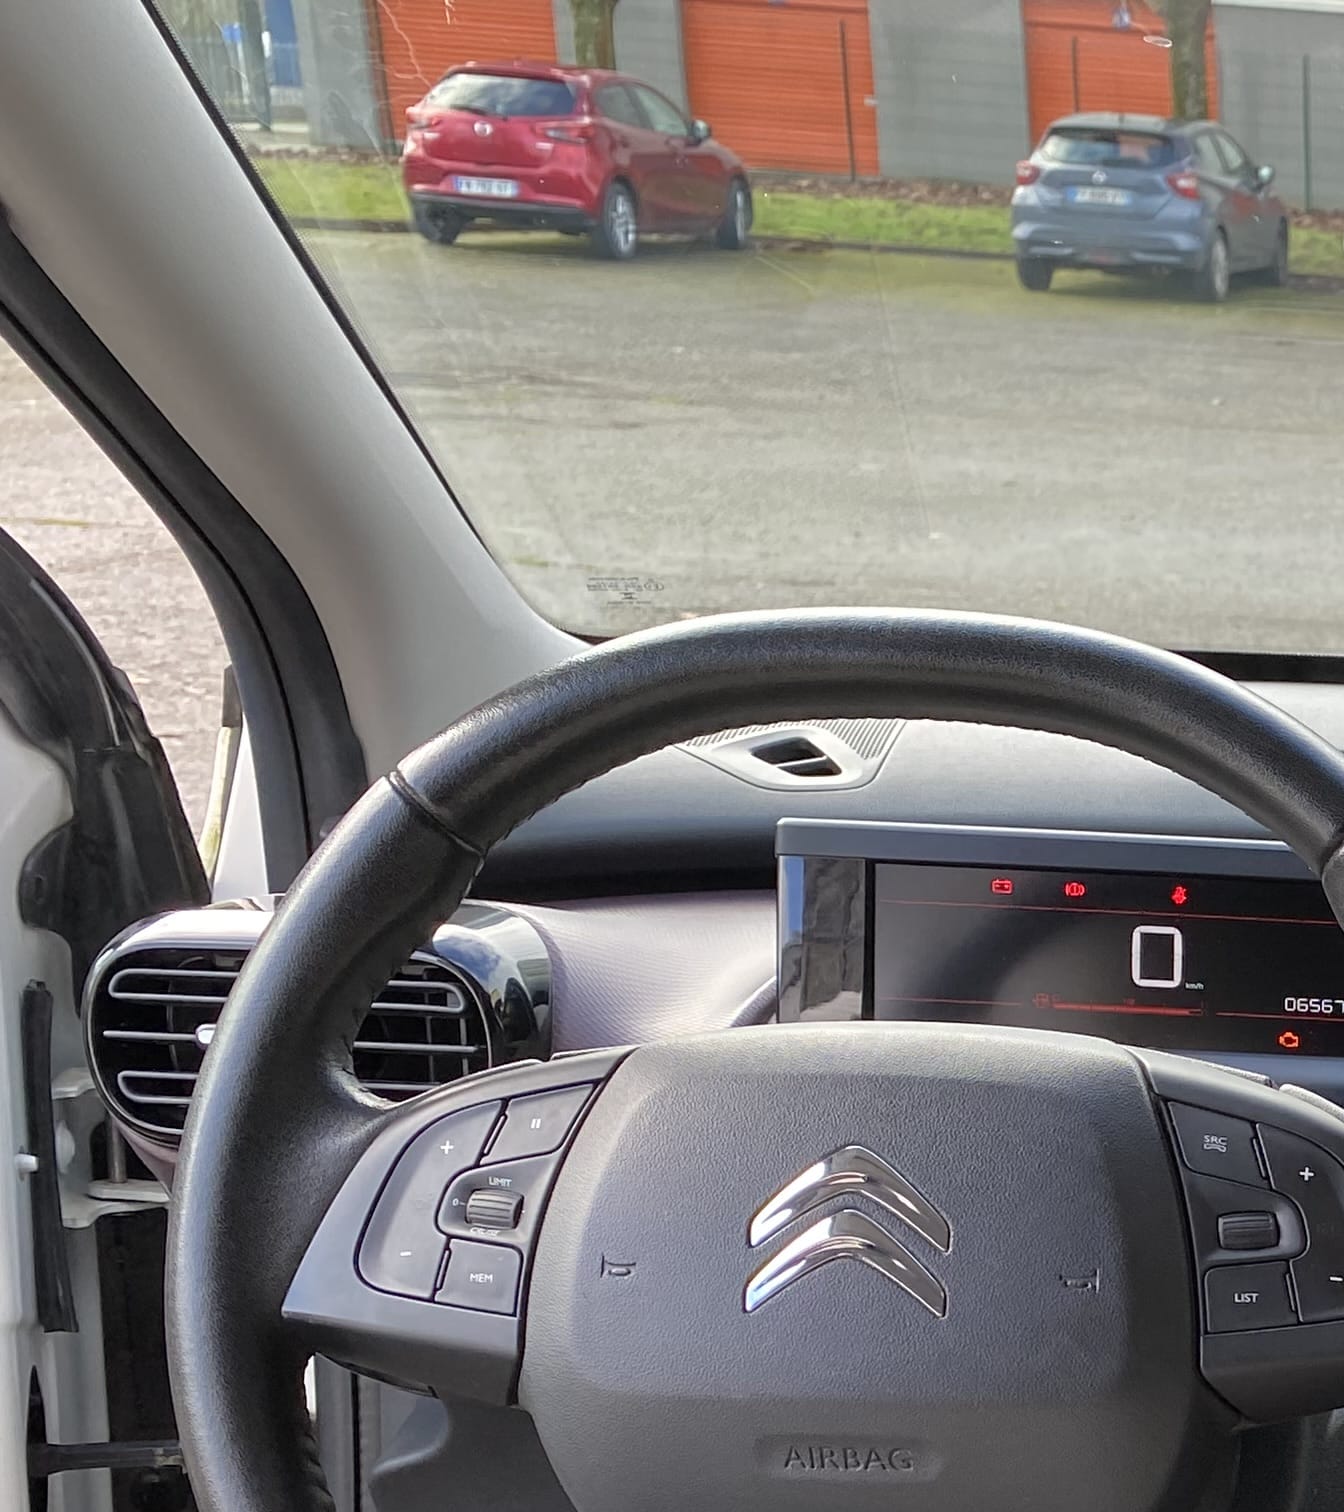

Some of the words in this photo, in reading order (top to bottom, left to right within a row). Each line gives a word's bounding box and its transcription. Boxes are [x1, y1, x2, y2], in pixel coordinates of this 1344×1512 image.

[1131, 924, 1183, 989] 0
[1203, 1135, 1228, 1145] SRC
[488, 1176, 512, 1187] LIMIT
[469, 1272, 494, 1284] MEM
[1234, 1292, 1259, 1303] LIST
[784, 1446, 914, 1471] AIRBAG
